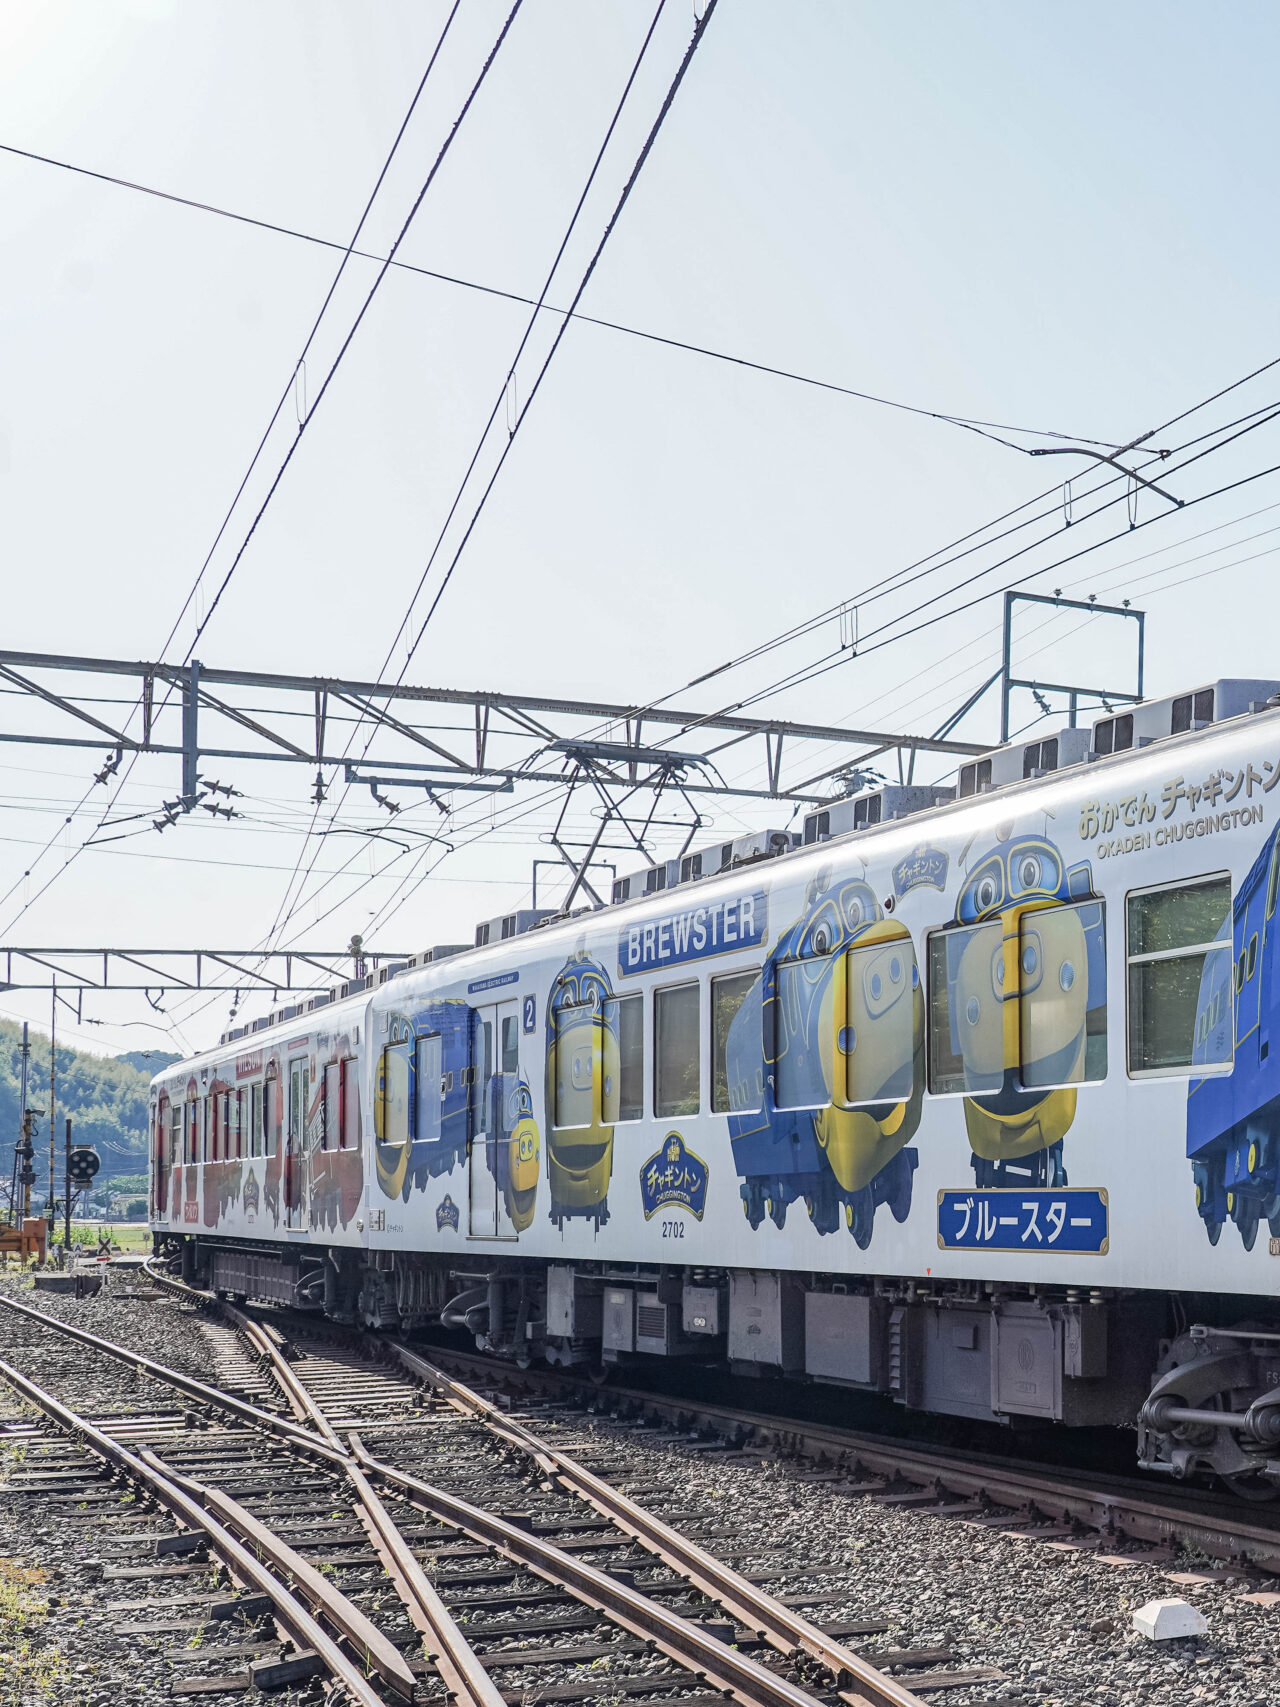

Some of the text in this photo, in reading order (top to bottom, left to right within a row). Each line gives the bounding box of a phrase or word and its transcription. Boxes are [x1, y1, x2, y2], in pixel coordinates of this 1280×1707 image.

[1079, 791, 1157, 840] おかでん
[1096, 804, 1264, 860] OKADEN CHUGGINGTON
[898, 859, 943, 885] チャギントン
[628, 895, 755, 966] BREWSTER
[526, 1000, 533, 1028] 2
[647, 1163, 701, 1197] チャギントン
[662, 1221, 685, 1238] 2702
[953, 1197, 1092, 1244] ブルースター
